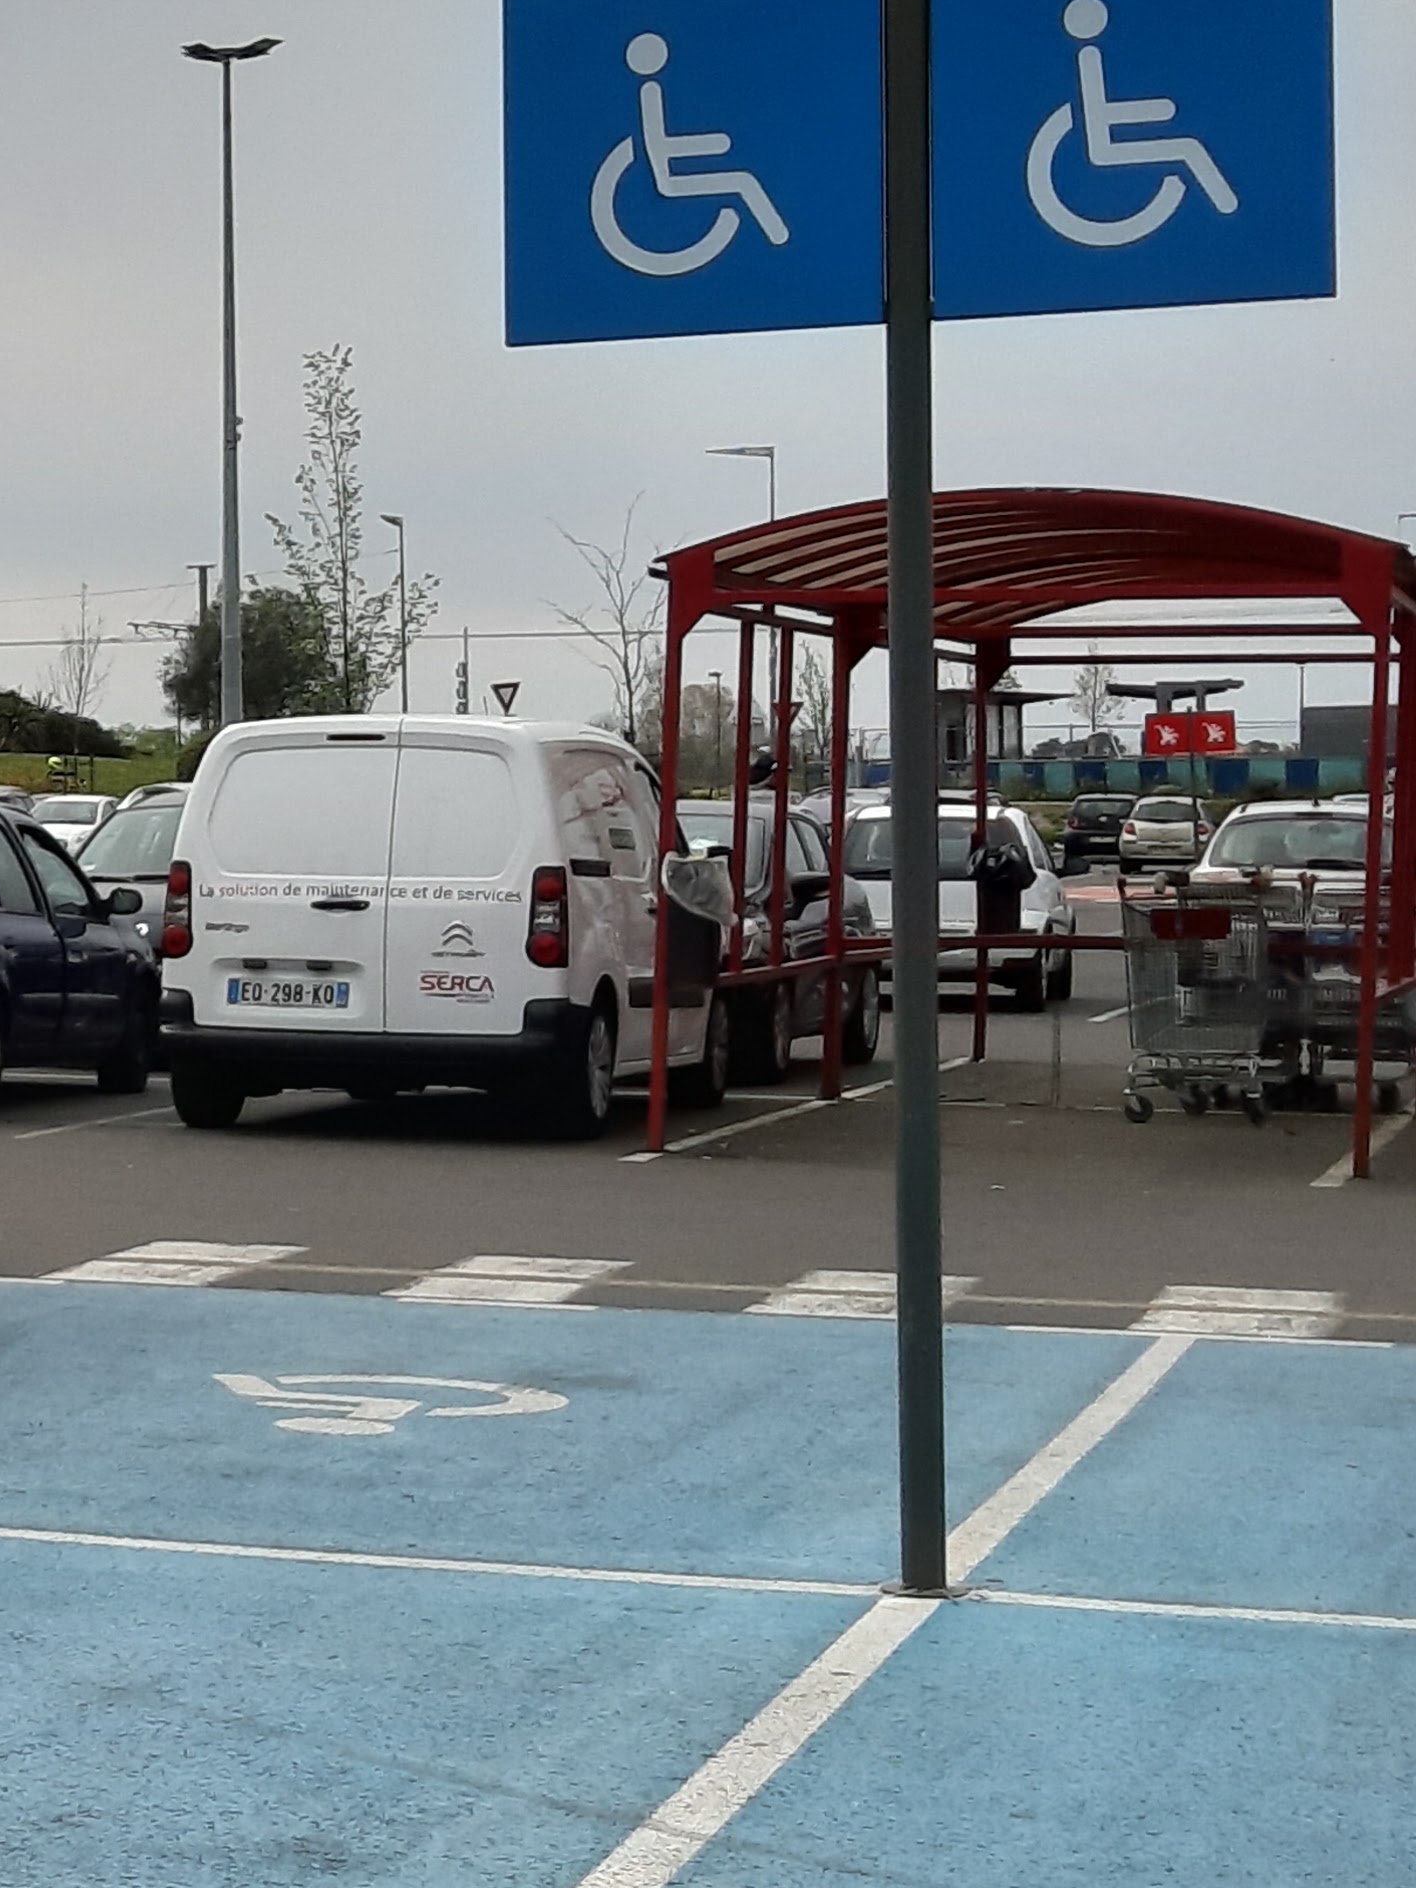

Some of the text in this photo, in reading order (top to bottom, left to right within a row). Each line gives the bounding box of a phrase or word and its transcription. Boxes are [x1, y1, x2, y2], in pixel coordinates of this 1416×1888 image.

[199, 884, 214, 898] La
[219, 883, 278, 897] solution
[283, 883, 301, 896] de
[412, 885, 428, 899] et
[433, 886, 452, 900] de
[457, 888, 522, 903] services
[420, 974, 495, 992] SERCA
